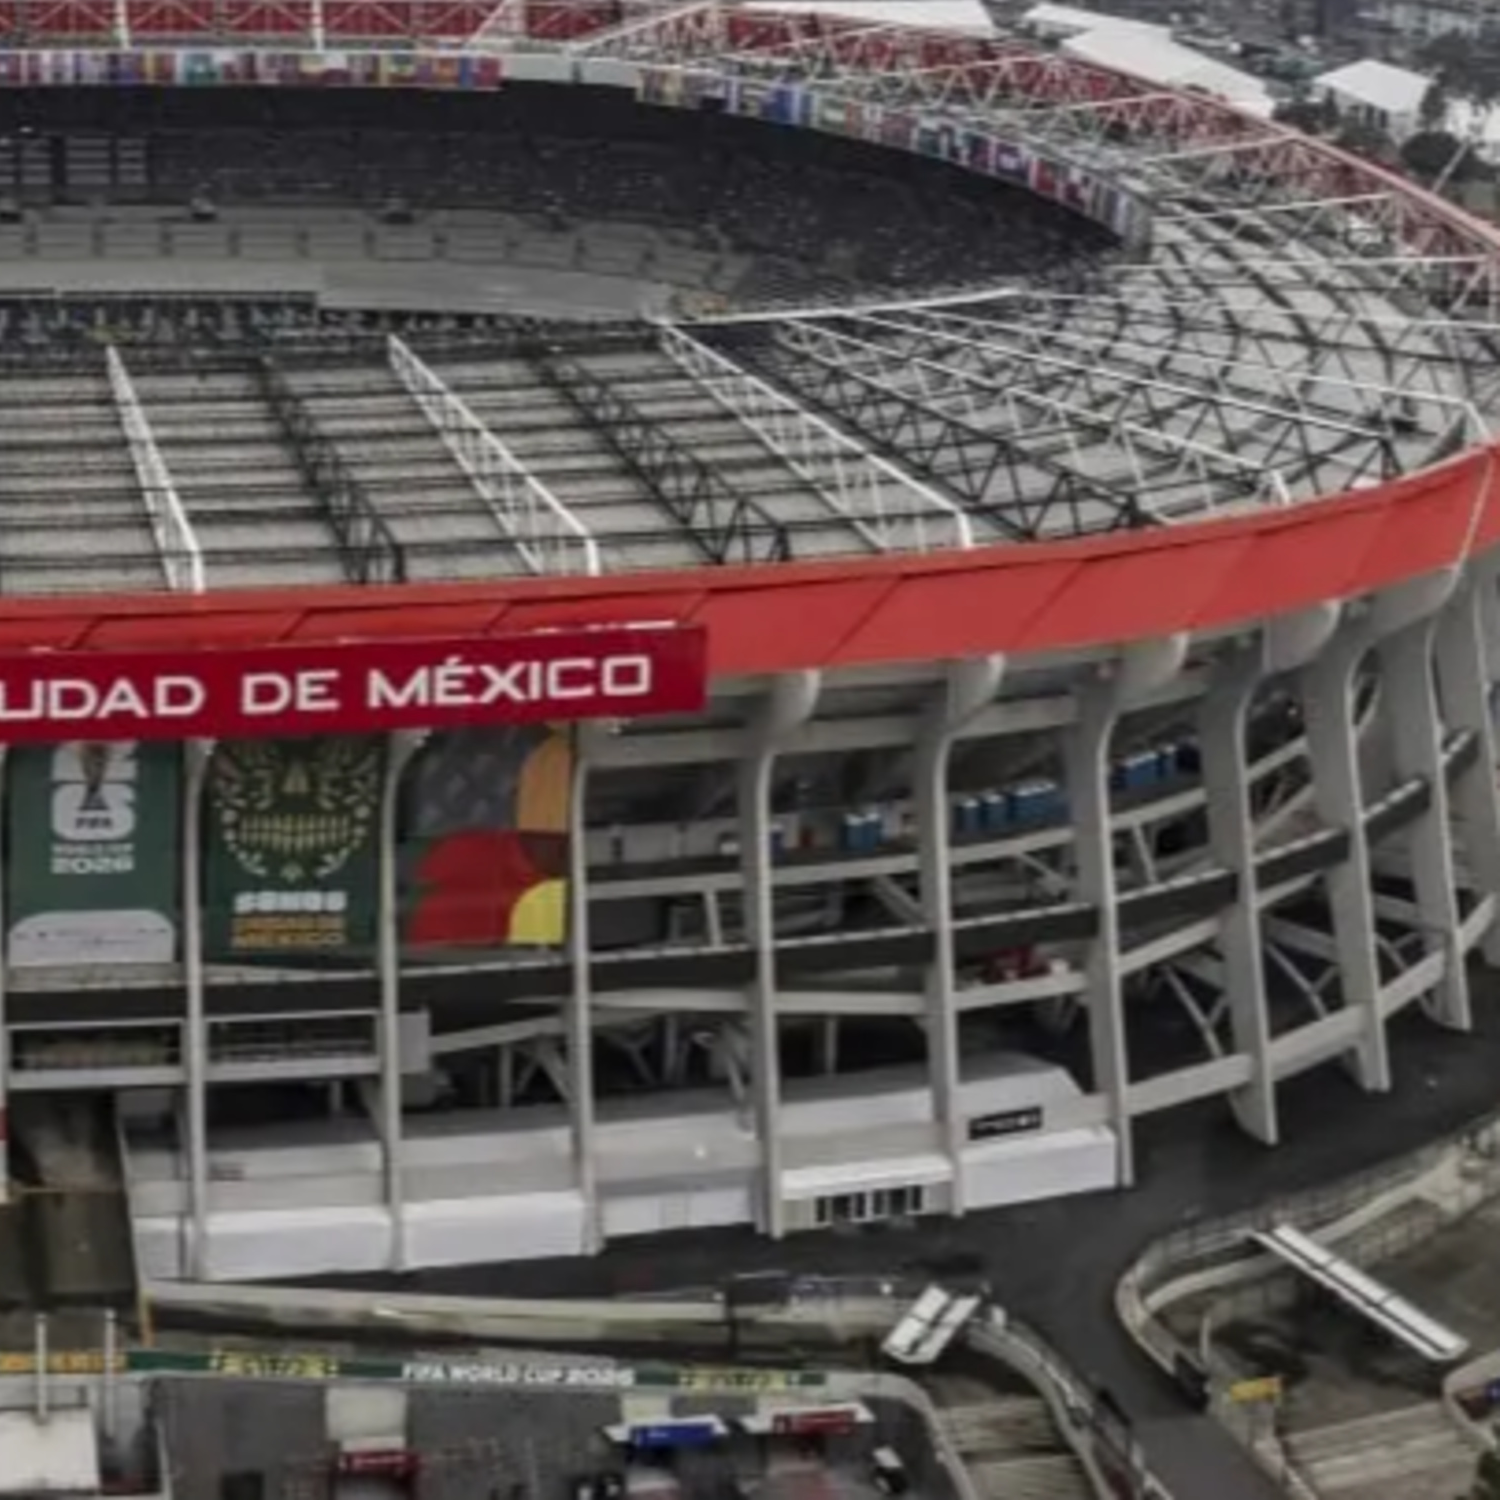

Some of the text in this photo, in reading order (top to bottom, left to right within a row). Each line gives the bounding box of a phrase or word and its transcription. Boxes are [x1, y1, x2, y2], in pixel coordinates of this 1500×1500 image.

[240, 669, 341, 715] DE
[367, 655, 653, 709] MÉXICO
[52, 857, 136, 875] 2026
